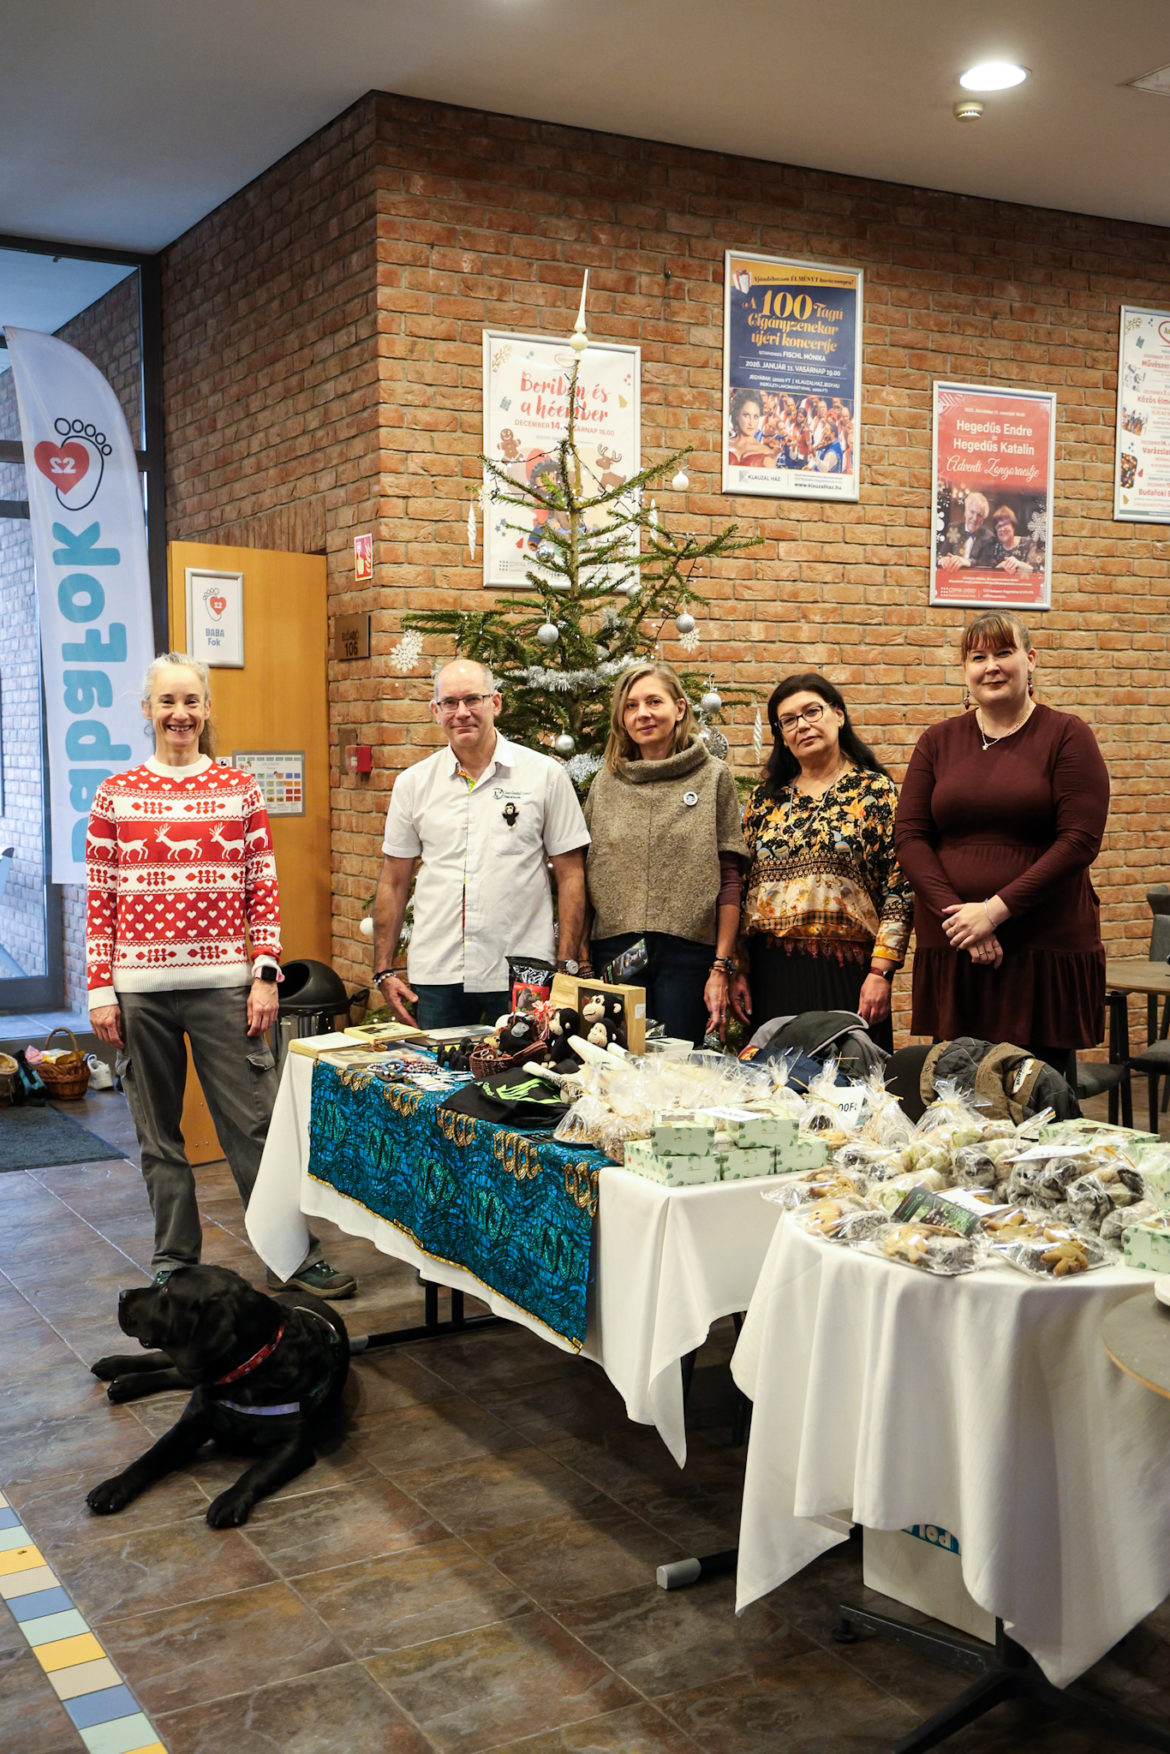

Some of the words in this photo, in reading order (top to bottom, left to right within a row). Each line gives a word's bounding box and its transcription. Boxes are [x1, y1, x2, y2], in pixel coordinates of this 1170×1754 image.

[762, 289, 813, 321] 100
[747, 313, 839, 337] Cigányzenekar
[781, 332, 838, 354] koncertje
[803, 352, 826, 362] MÓNIKA
[762, 361, 786, 371] JANUÁR
[795, 364, 826, 376] VASÁRNAP
[520, 371, 585, 400] Boribn
[592, 383, 609, 403] és
[514, 419, 550, 428] DECEMBER
[956, 419, 1001, 434] Hegedűs
[1003, 422, 1033, 437] Endre
[953, 438, 998, 453] Hegedűs
[1000, 440, 1035, 456] Katalin
[947, 455, 982, 473] Adventi
[205, 628, 224, 638] BABA
[208, 638, 221, 647] Fok
